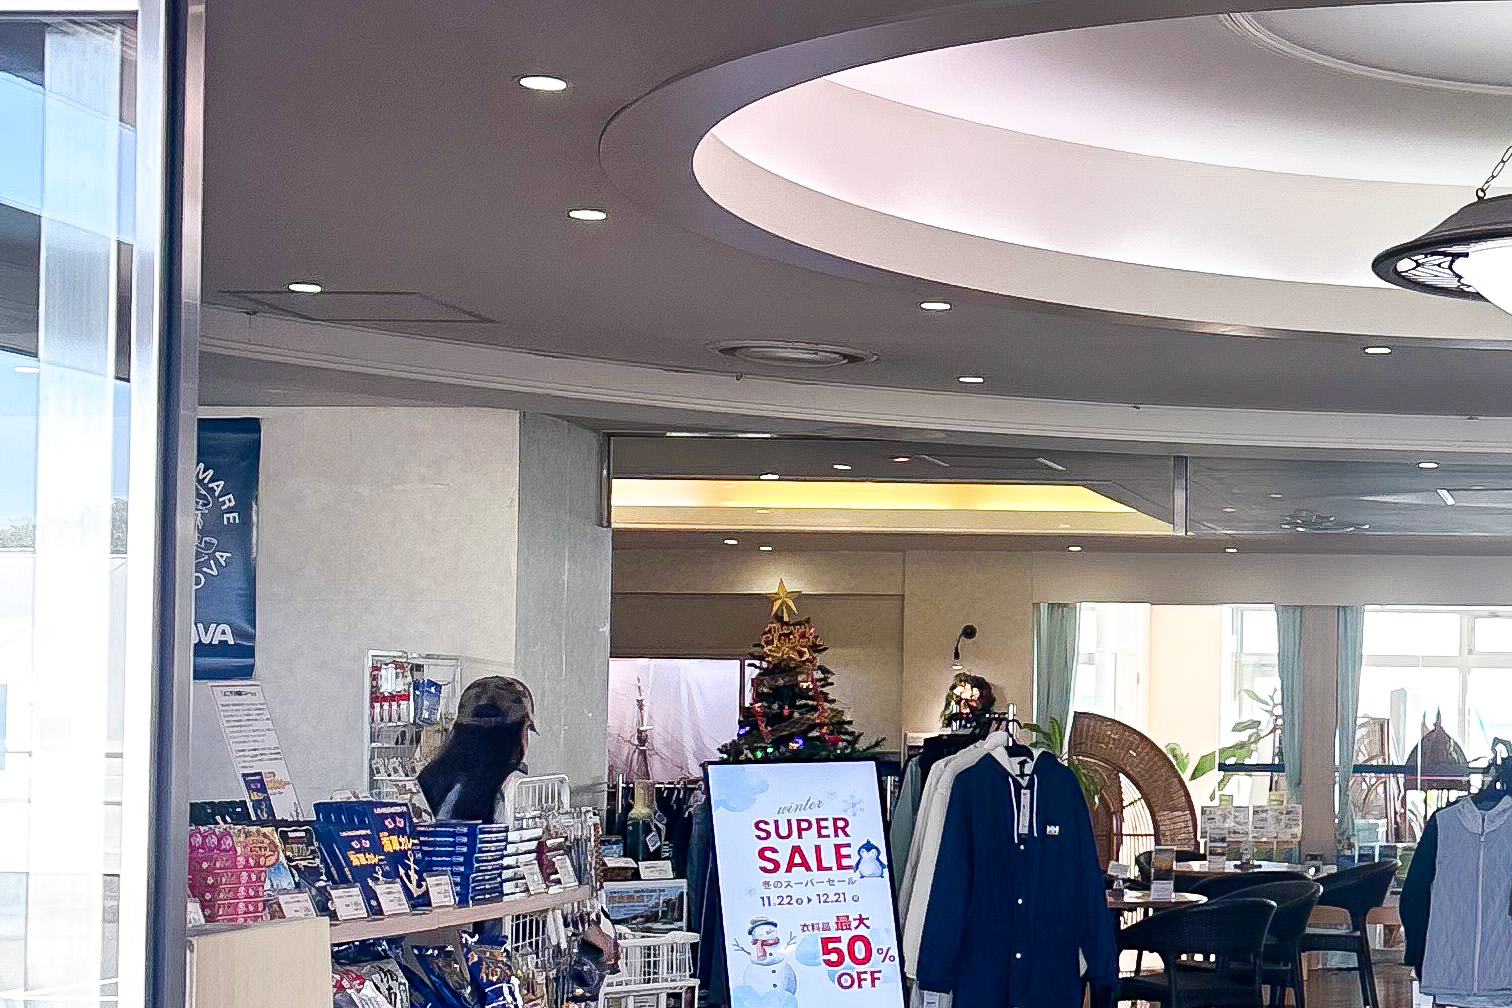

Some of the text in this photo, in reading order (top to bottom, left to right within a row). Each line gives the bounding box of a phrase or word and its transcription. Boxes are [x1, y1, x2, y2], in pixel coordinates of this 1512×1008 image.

[776, 795, 825, 816] winter
[754, 816, 852, 841] SUPER
[757, 843, 854, 875] SALE
[761, 877, 857, 890] 冬のスーパーセール
[759, 895, 794, 907] 11.22
[815, 892, 847, 904] 12.21
[834, 913, 871, 932] 最大
[836, 969, 882, 990] OFF
